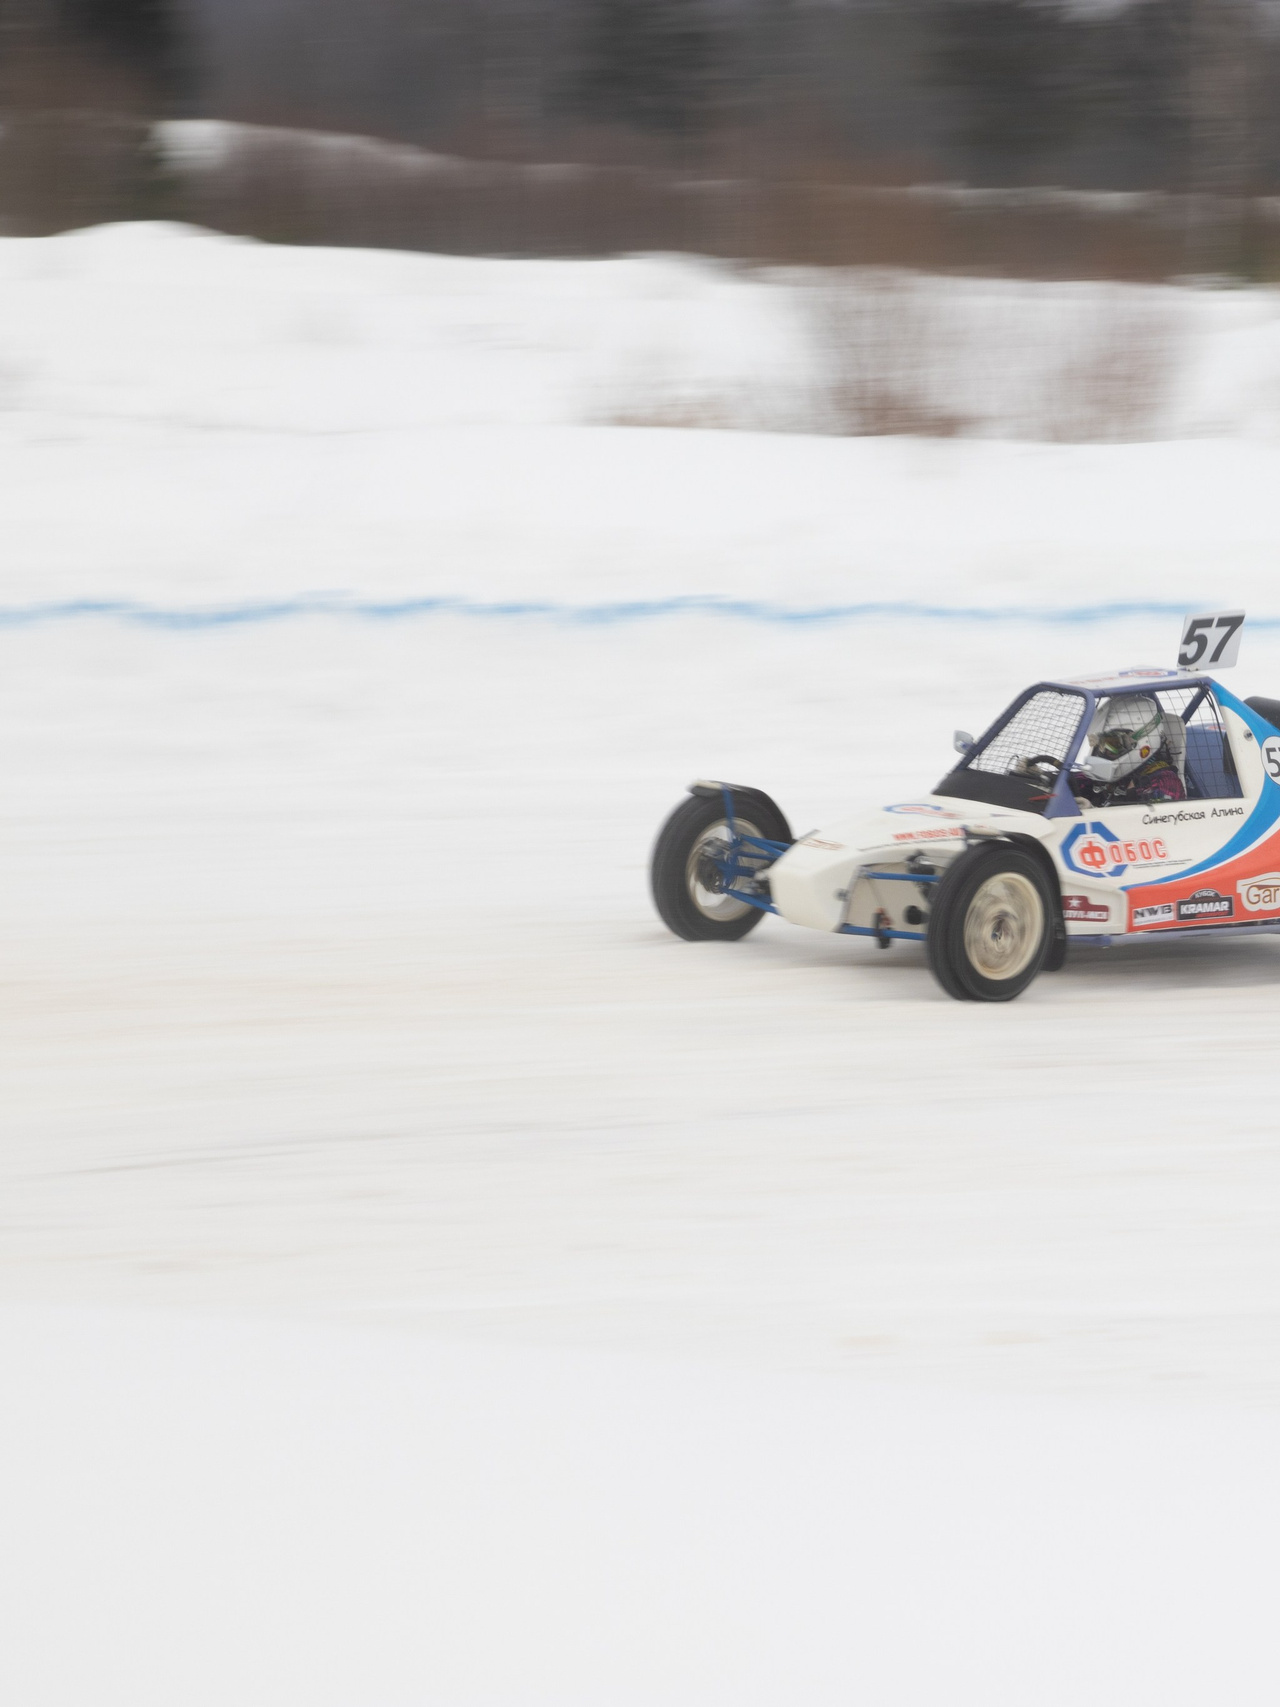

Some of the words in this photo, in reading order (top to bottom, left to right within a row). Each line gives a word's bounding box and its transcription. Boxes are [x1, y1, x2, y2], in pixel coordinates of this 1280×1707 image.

[1178, 615, 1245, 666] 57
[1142, 811, 1206, 825] Синегубская
[1211, 807, 1244, 818] Алина
[1135, 904, 1172, 918] NWB
[1180, 901, 1230, 914] KRAMAR
